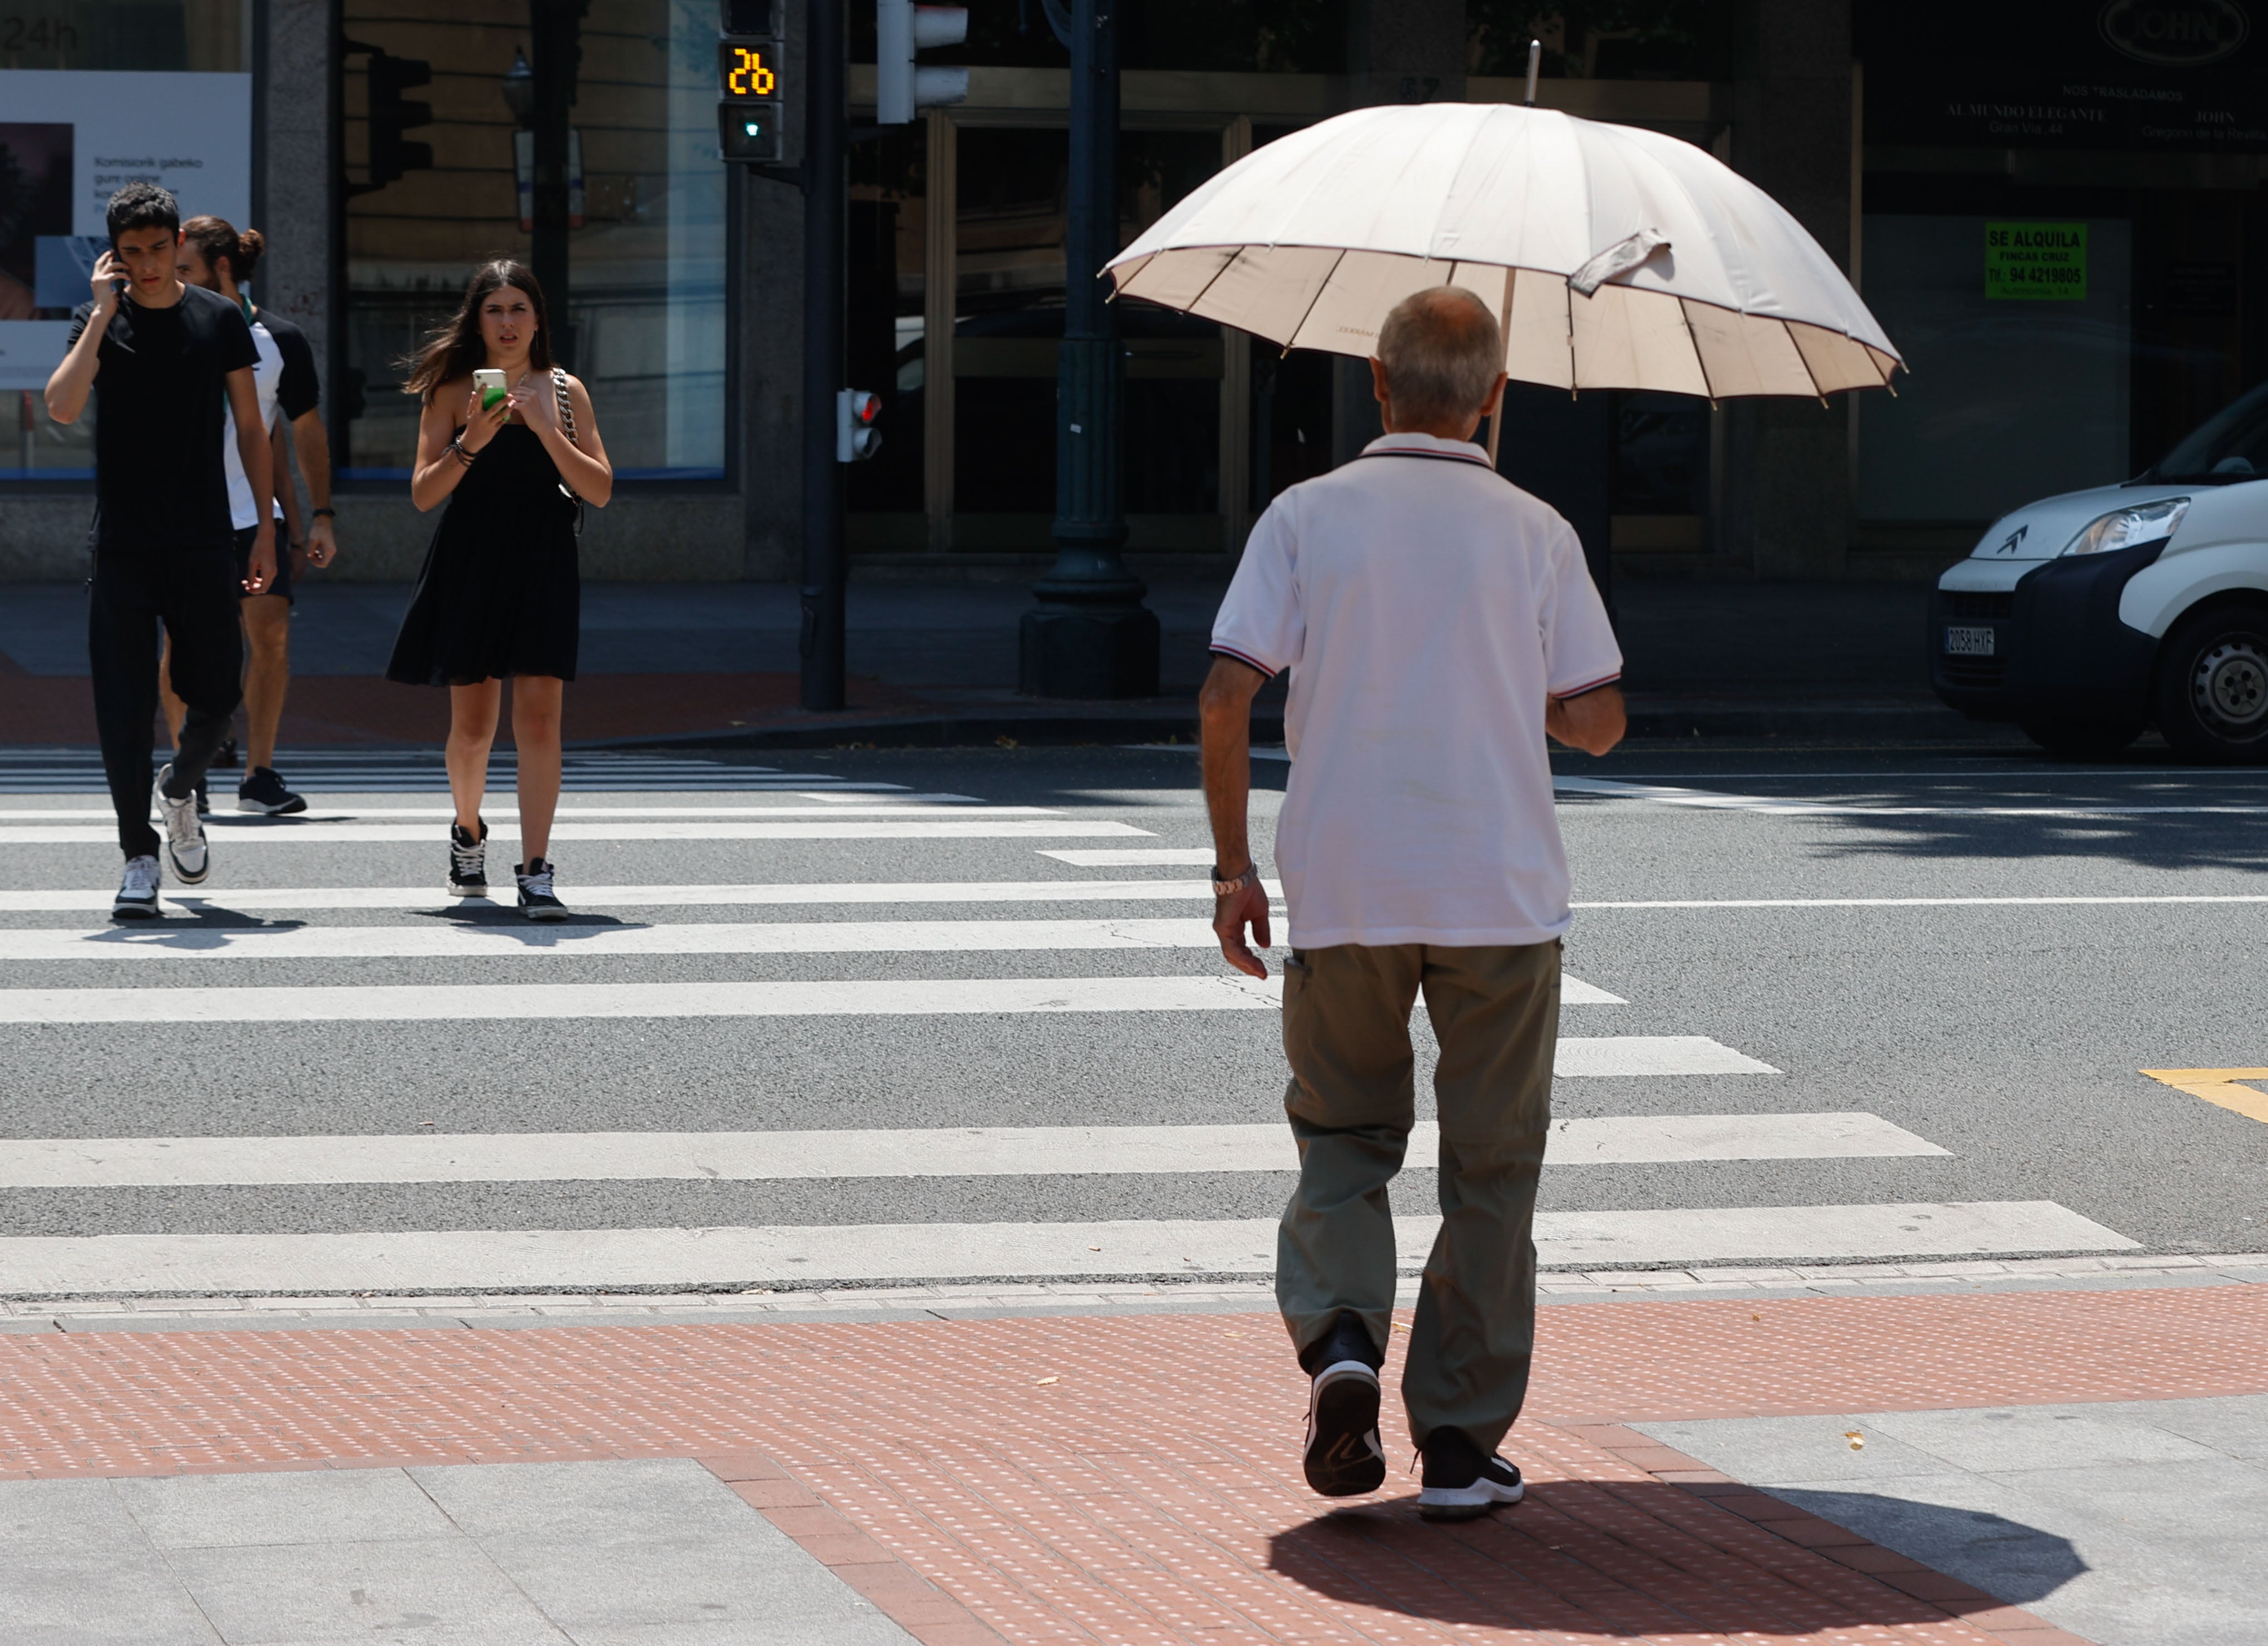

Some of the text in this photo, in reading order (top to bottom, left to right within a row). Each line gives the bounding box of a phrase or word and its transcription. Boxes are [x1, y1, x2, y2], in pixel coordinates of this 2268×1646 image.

[3, 16, 77, 50] 24h
[2132, 8, 2218, 42] JOHN
[728, 47, 775, 95] 26
[2062, 85, 2088, 97] NOS
[1946, 103, 2108, 122] AL MUNDO ELEGANTE
[2194, 110, 2236, 124] JOHN
[1989, 120, 2019, 134] Gran
[2141, 125, 2193, 142] Gregorio
[2195, 126, 2211, 139] de
[2213, 126, 2225, 139] la
[93, 174, 121, 186] gure
[1989, 230, 2081, 248] SE ALQUILA
[2000, 252, 2070, 262] FINCAS CRUZ
[2010, 267, 2025, 283] 94
[2029, 267, 2082, 284] 4219805
[1949, 629, 1993, 653] 2058 HXF
